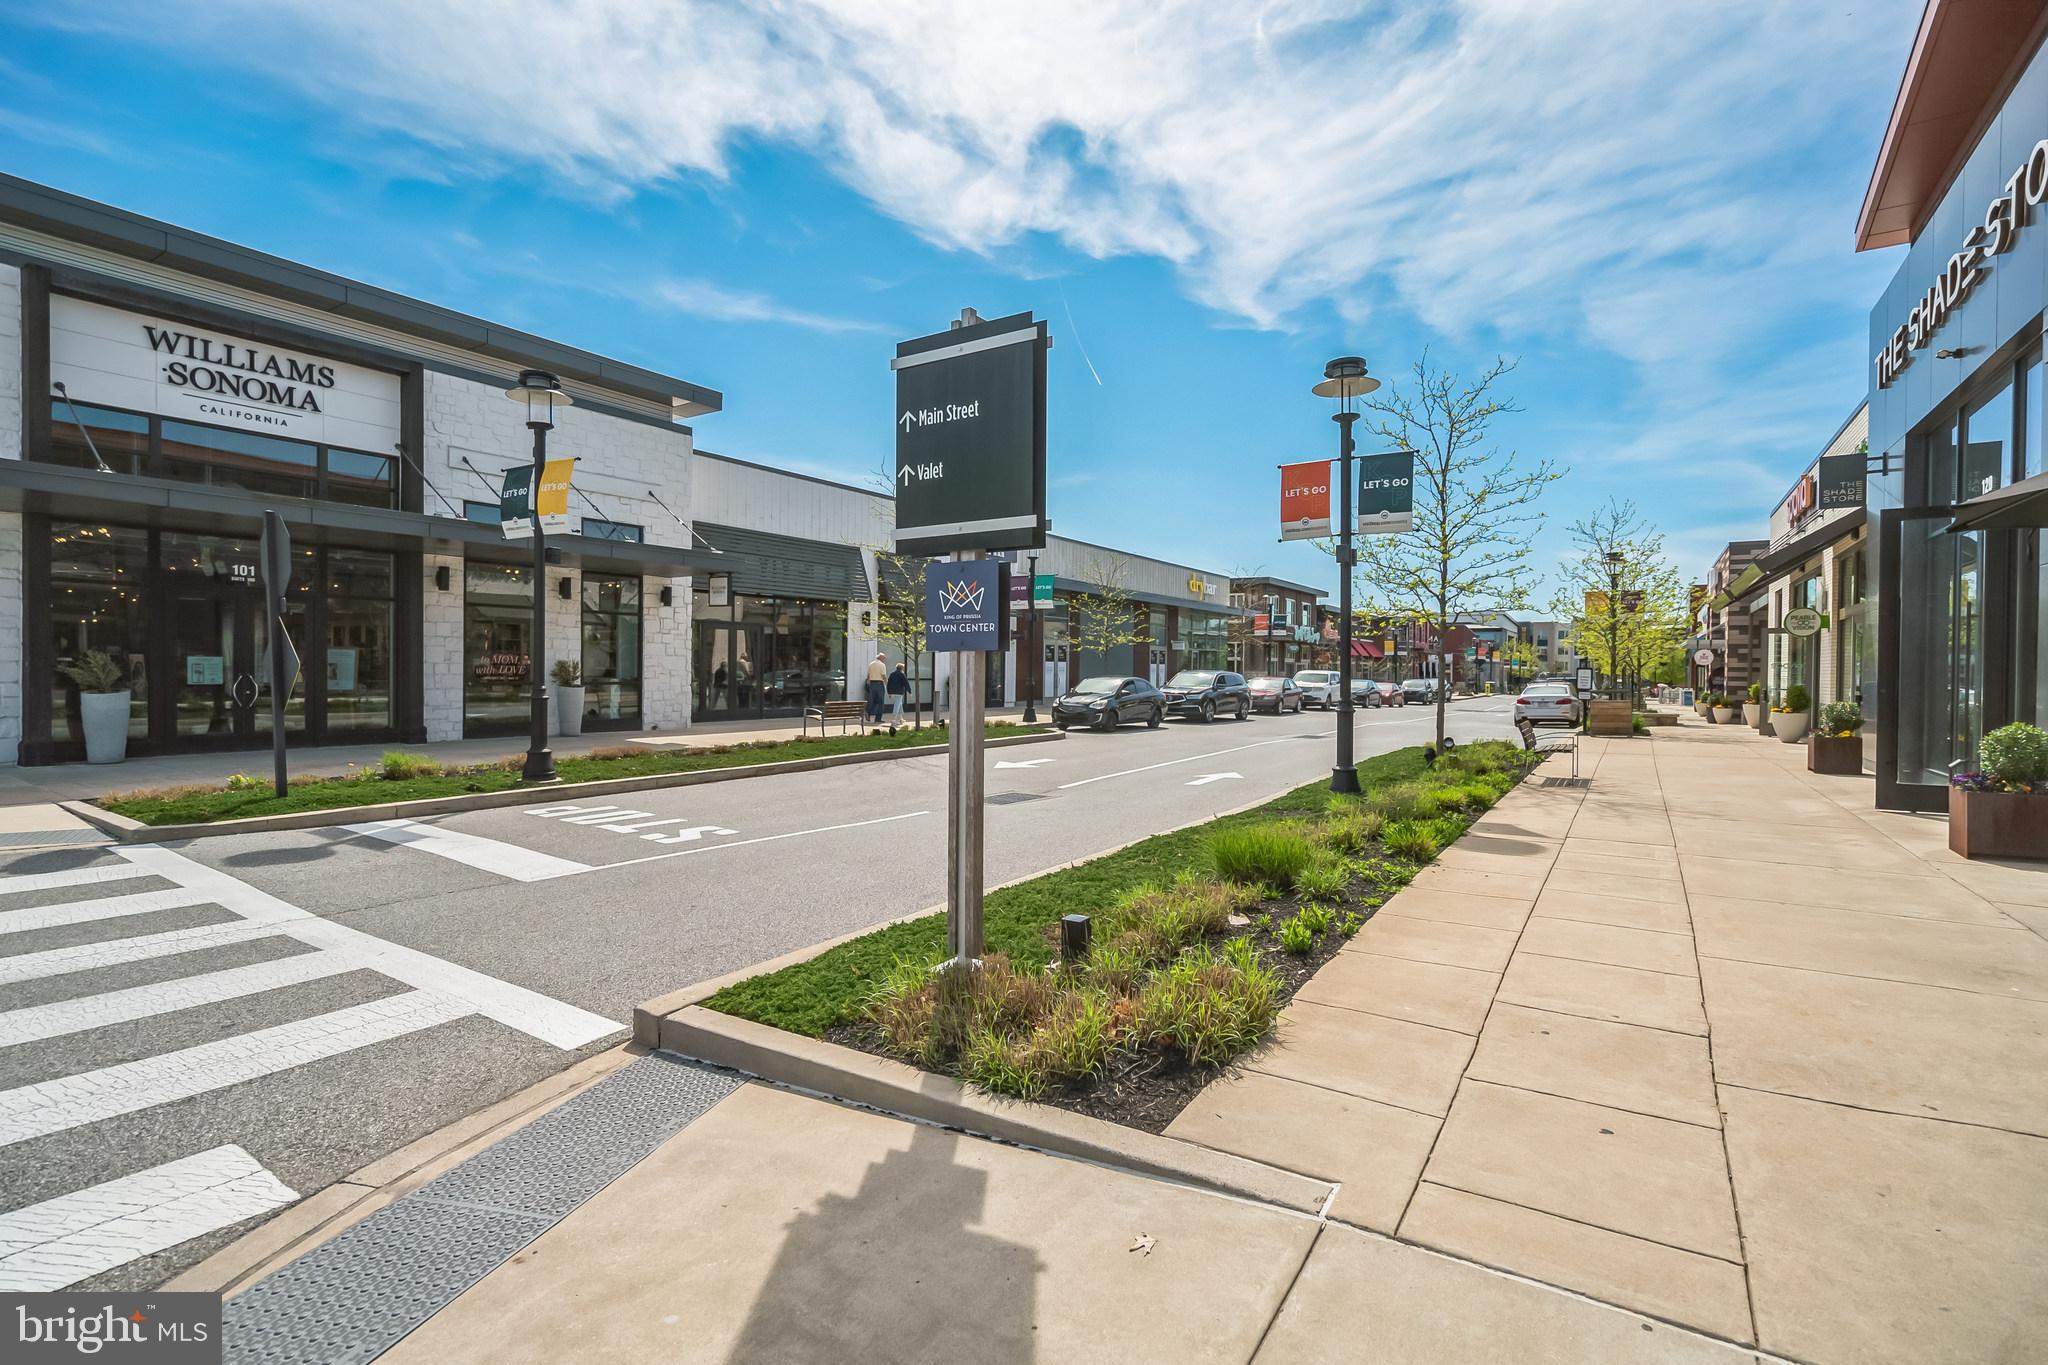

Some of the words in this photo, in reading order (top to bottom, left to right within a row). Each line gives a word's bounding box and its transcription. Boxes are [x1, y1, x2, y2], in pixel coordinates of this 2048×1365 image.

[1875, 325, 1904, 390] THE
[1907, 227, 1979, 351] SHADE
[143, 325, 335, 388] WILLIAMS
[199, 404, 289, 427] CALIFORNIA
[918, 407, 944, 426] Main
[946, 400, 980, 422] Street
[917, 462, 944, 480] Valet
[541, 482, 557, 492] LET'S
[557, 482, 567, 490] GO
[1363, 478, 1390, 490] LET'S
[1392, 477, 1409, 487] GO
[1840, 480, 1863, 488] THE
[503, 488, 518, 498] LET'S
[518, 487, 528, 496] GO
[1285, 486, 1310, 498] LET'S
[1311, 485, 1327, 495] GO
[1823, 487, 1863, 497] SHADE
[1823, 494, 1863, 503] STORE
[231, 564, 255, 577] 101
[1189, 573, 1217, 600] drybar
[929, 624, 957, 633] TOWN
[959, 622, 995, 633] CENTER
